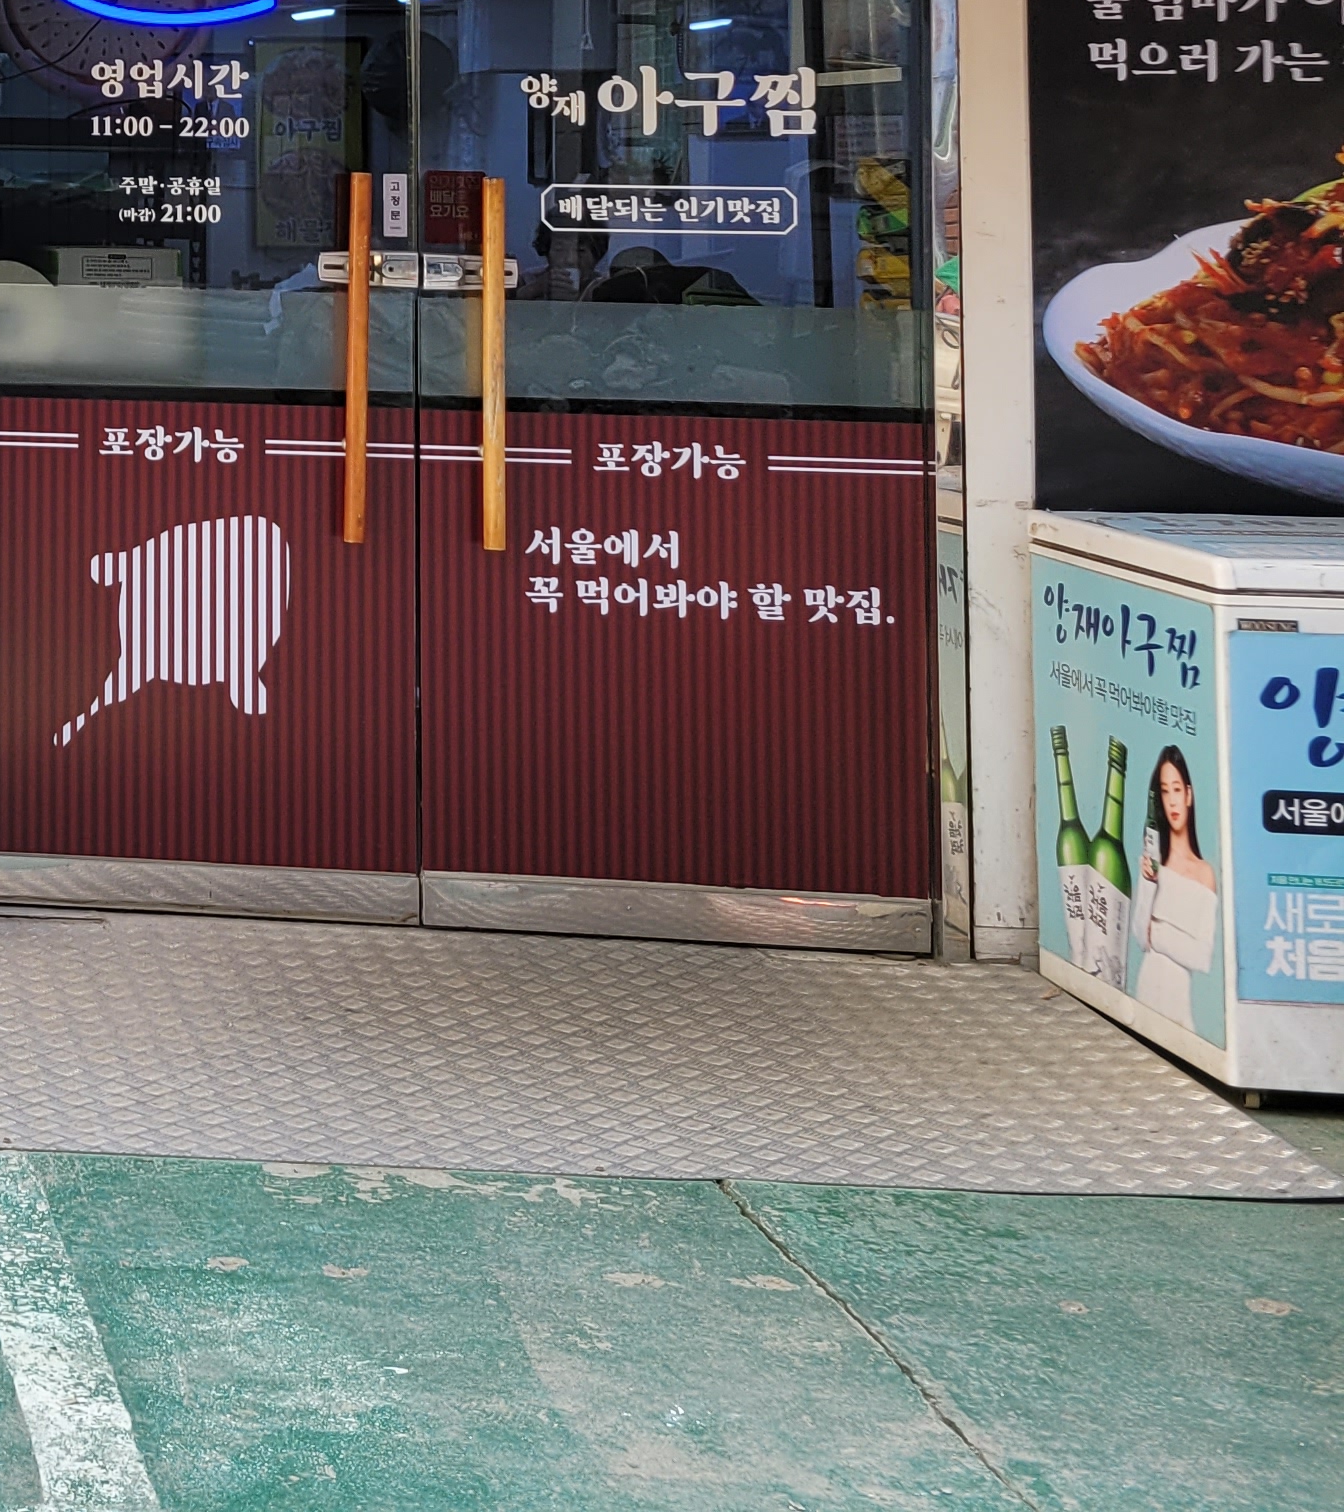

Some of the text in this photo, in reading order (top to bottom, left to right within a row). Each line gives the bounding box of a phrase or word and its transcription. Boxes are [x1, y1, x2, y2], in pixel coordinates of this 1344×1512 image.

[90, 58, 250, 100] 영업시간
[1087, 37, 1330, 83] 먹으러 가는
[520, 65, 817, 137] 양재 아구찜
[90, 115, 154, 137] 11:00
[179, 116, 250, 138] 22:00
[118, 203, 222, 224] (마감) 21:00
[558, 194, 780, 224] 배달되는 인기맛집
[98, 425, 245, 464] 포장가능
[592, 440, 747, 480] 포장가능
[524, 526, 679, 570] 서울에서
[524, 576, 895, 626] 꼭 먹어봐야 할 맛집.
[1050, 661, 1093, 698] 서울에서
